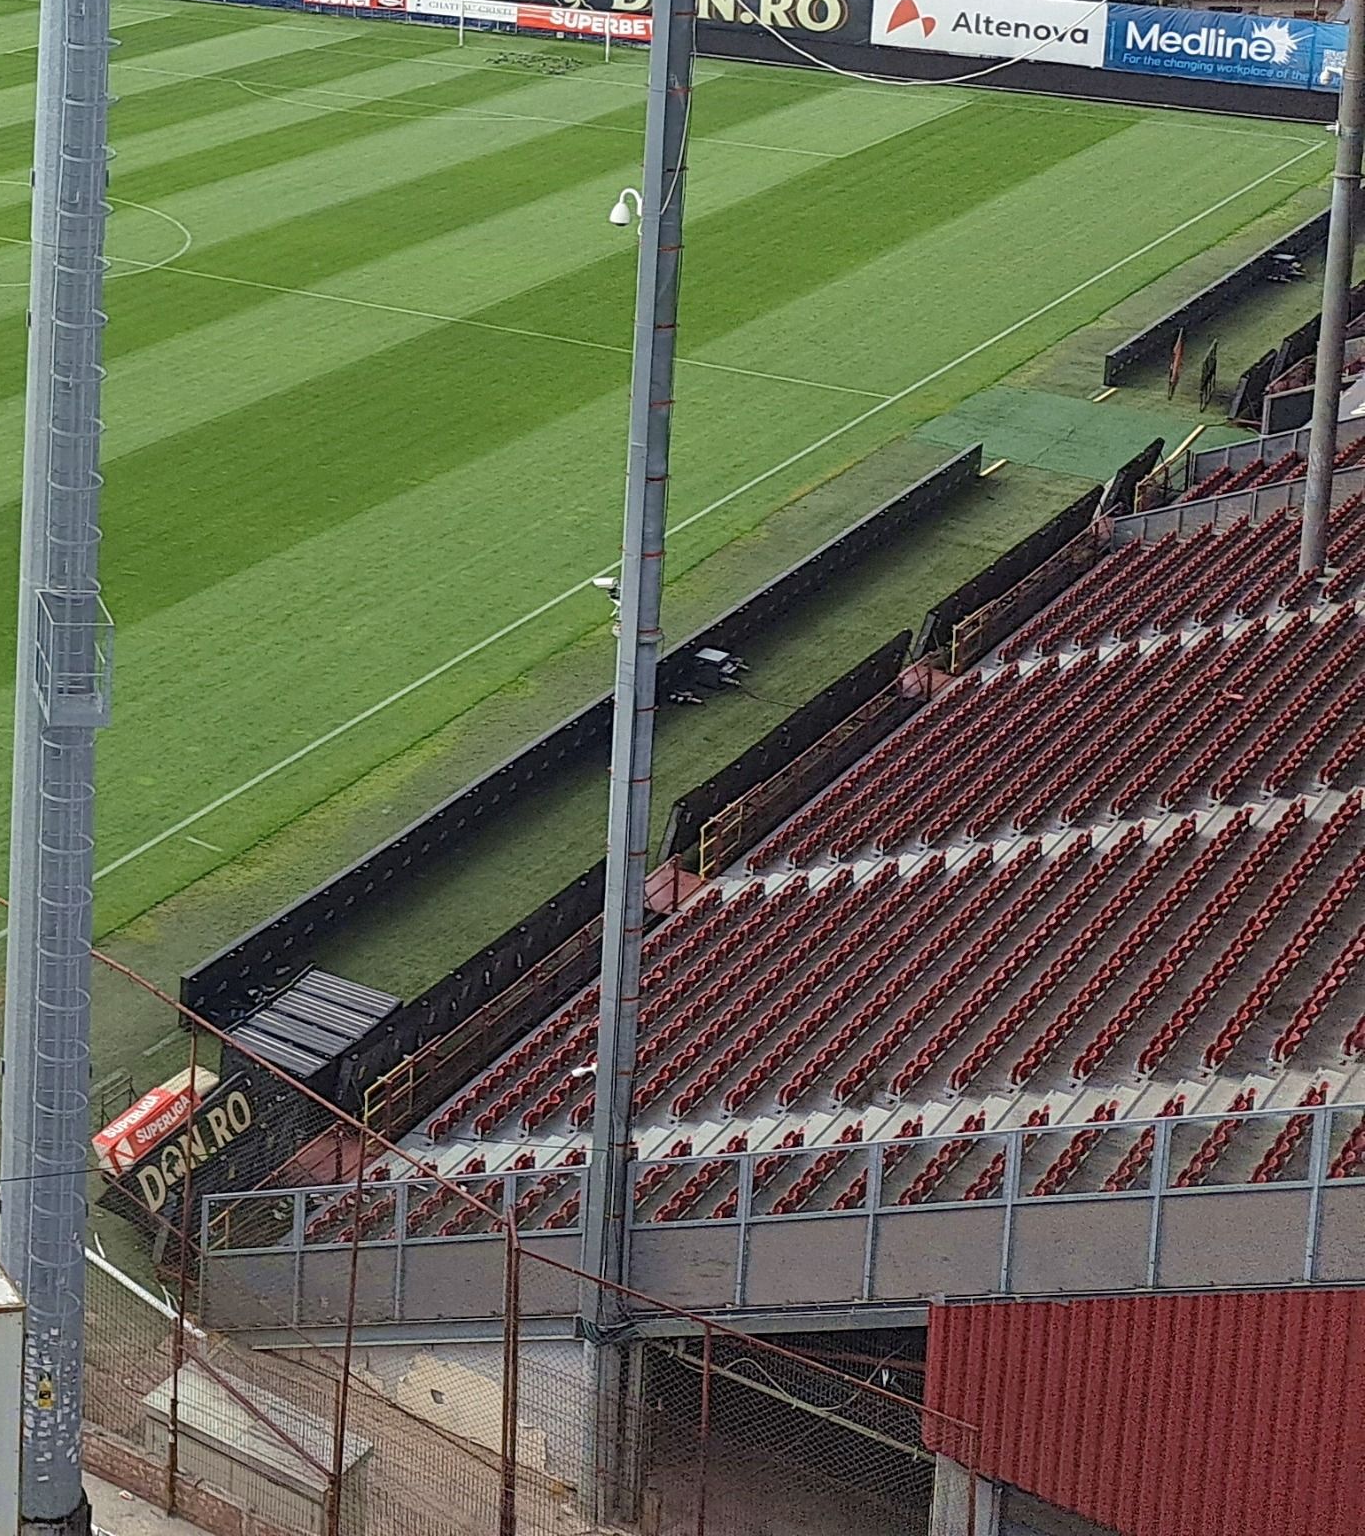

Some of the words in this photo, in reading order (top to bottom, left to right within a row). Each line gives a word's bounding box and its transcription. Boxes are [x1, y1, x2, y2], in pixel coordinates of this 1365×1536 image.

[951, 11, 1090, 45] Altenova
[1125, 20, 1274, 62] Medline
[1122, 52, 1142, 64] For
[1143, 55, 1161, 66] the
[1163, 57, 1214, 74] changing
[101, 1093, 161, 1139] SUPERLIGA
[134, 1093, 192, 1145] SUPERLIGA
